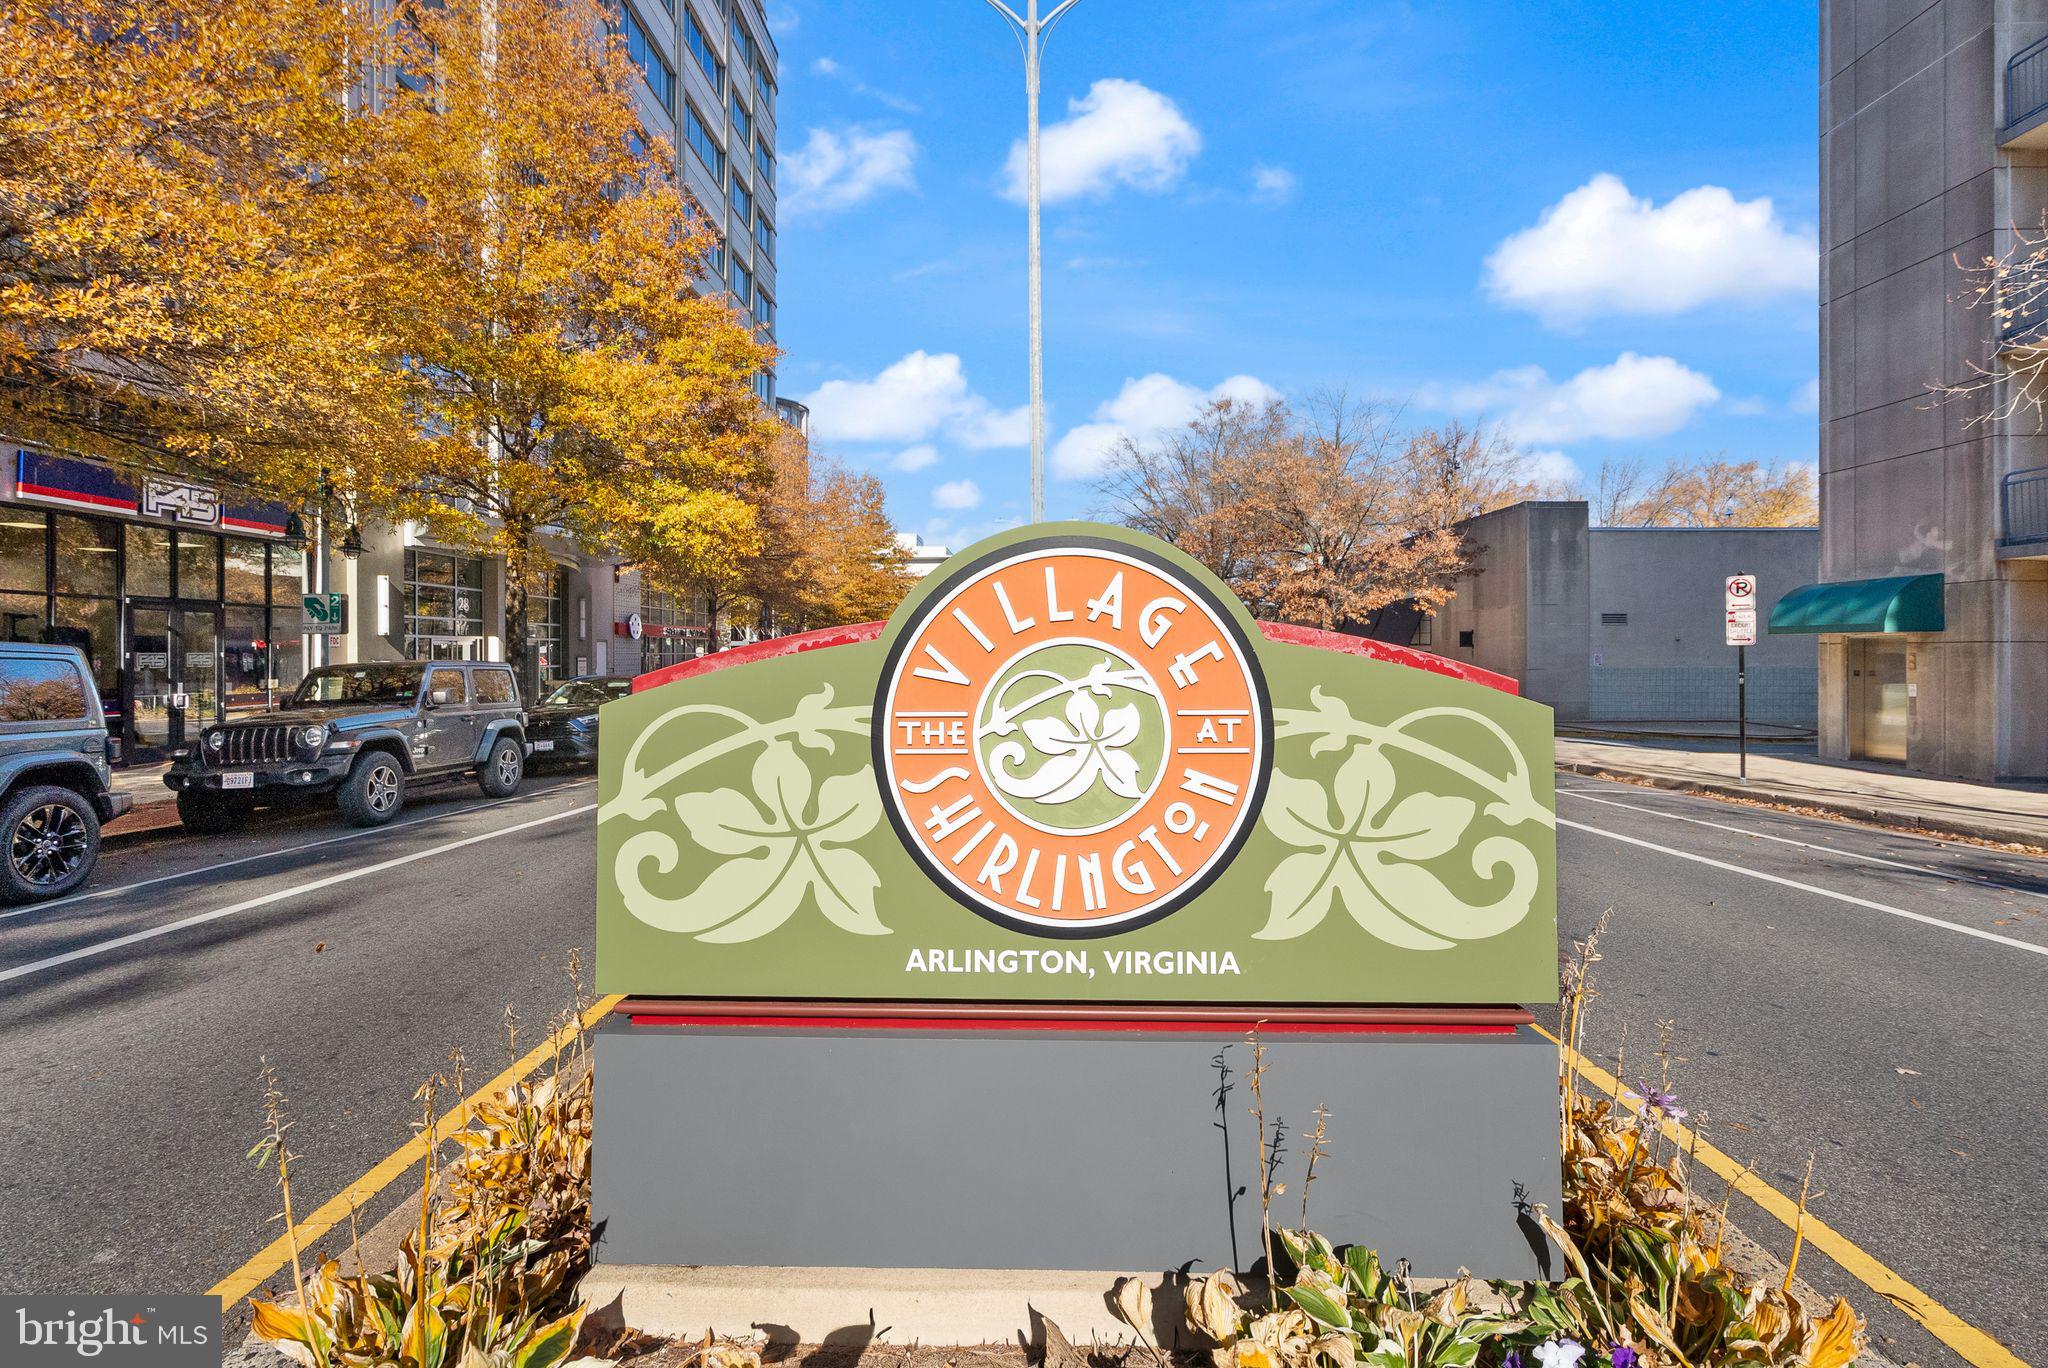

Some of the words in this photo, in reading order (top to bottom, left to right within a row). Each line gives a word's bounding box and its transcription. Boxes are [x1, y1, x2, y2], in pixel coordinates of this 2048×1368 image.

[142, 477, 220, 526] F45
[331, 596, 339, 606] 2
[913, 566, 1224, 689] VILLAGE
[330, 636, 340, 645] FDC
[137, 652, 167, 668] F45
[186, 652, 214, 667] F45
[898, 721, 966, 745] THE
[1196, 718, 1242, 743] AT
[900, 766, 1239, 911] SHIRLINGTON
[905, 948, 1095, 979] ARLINGTON,
[1103, 950, 1241, 975] VIRGINIA
